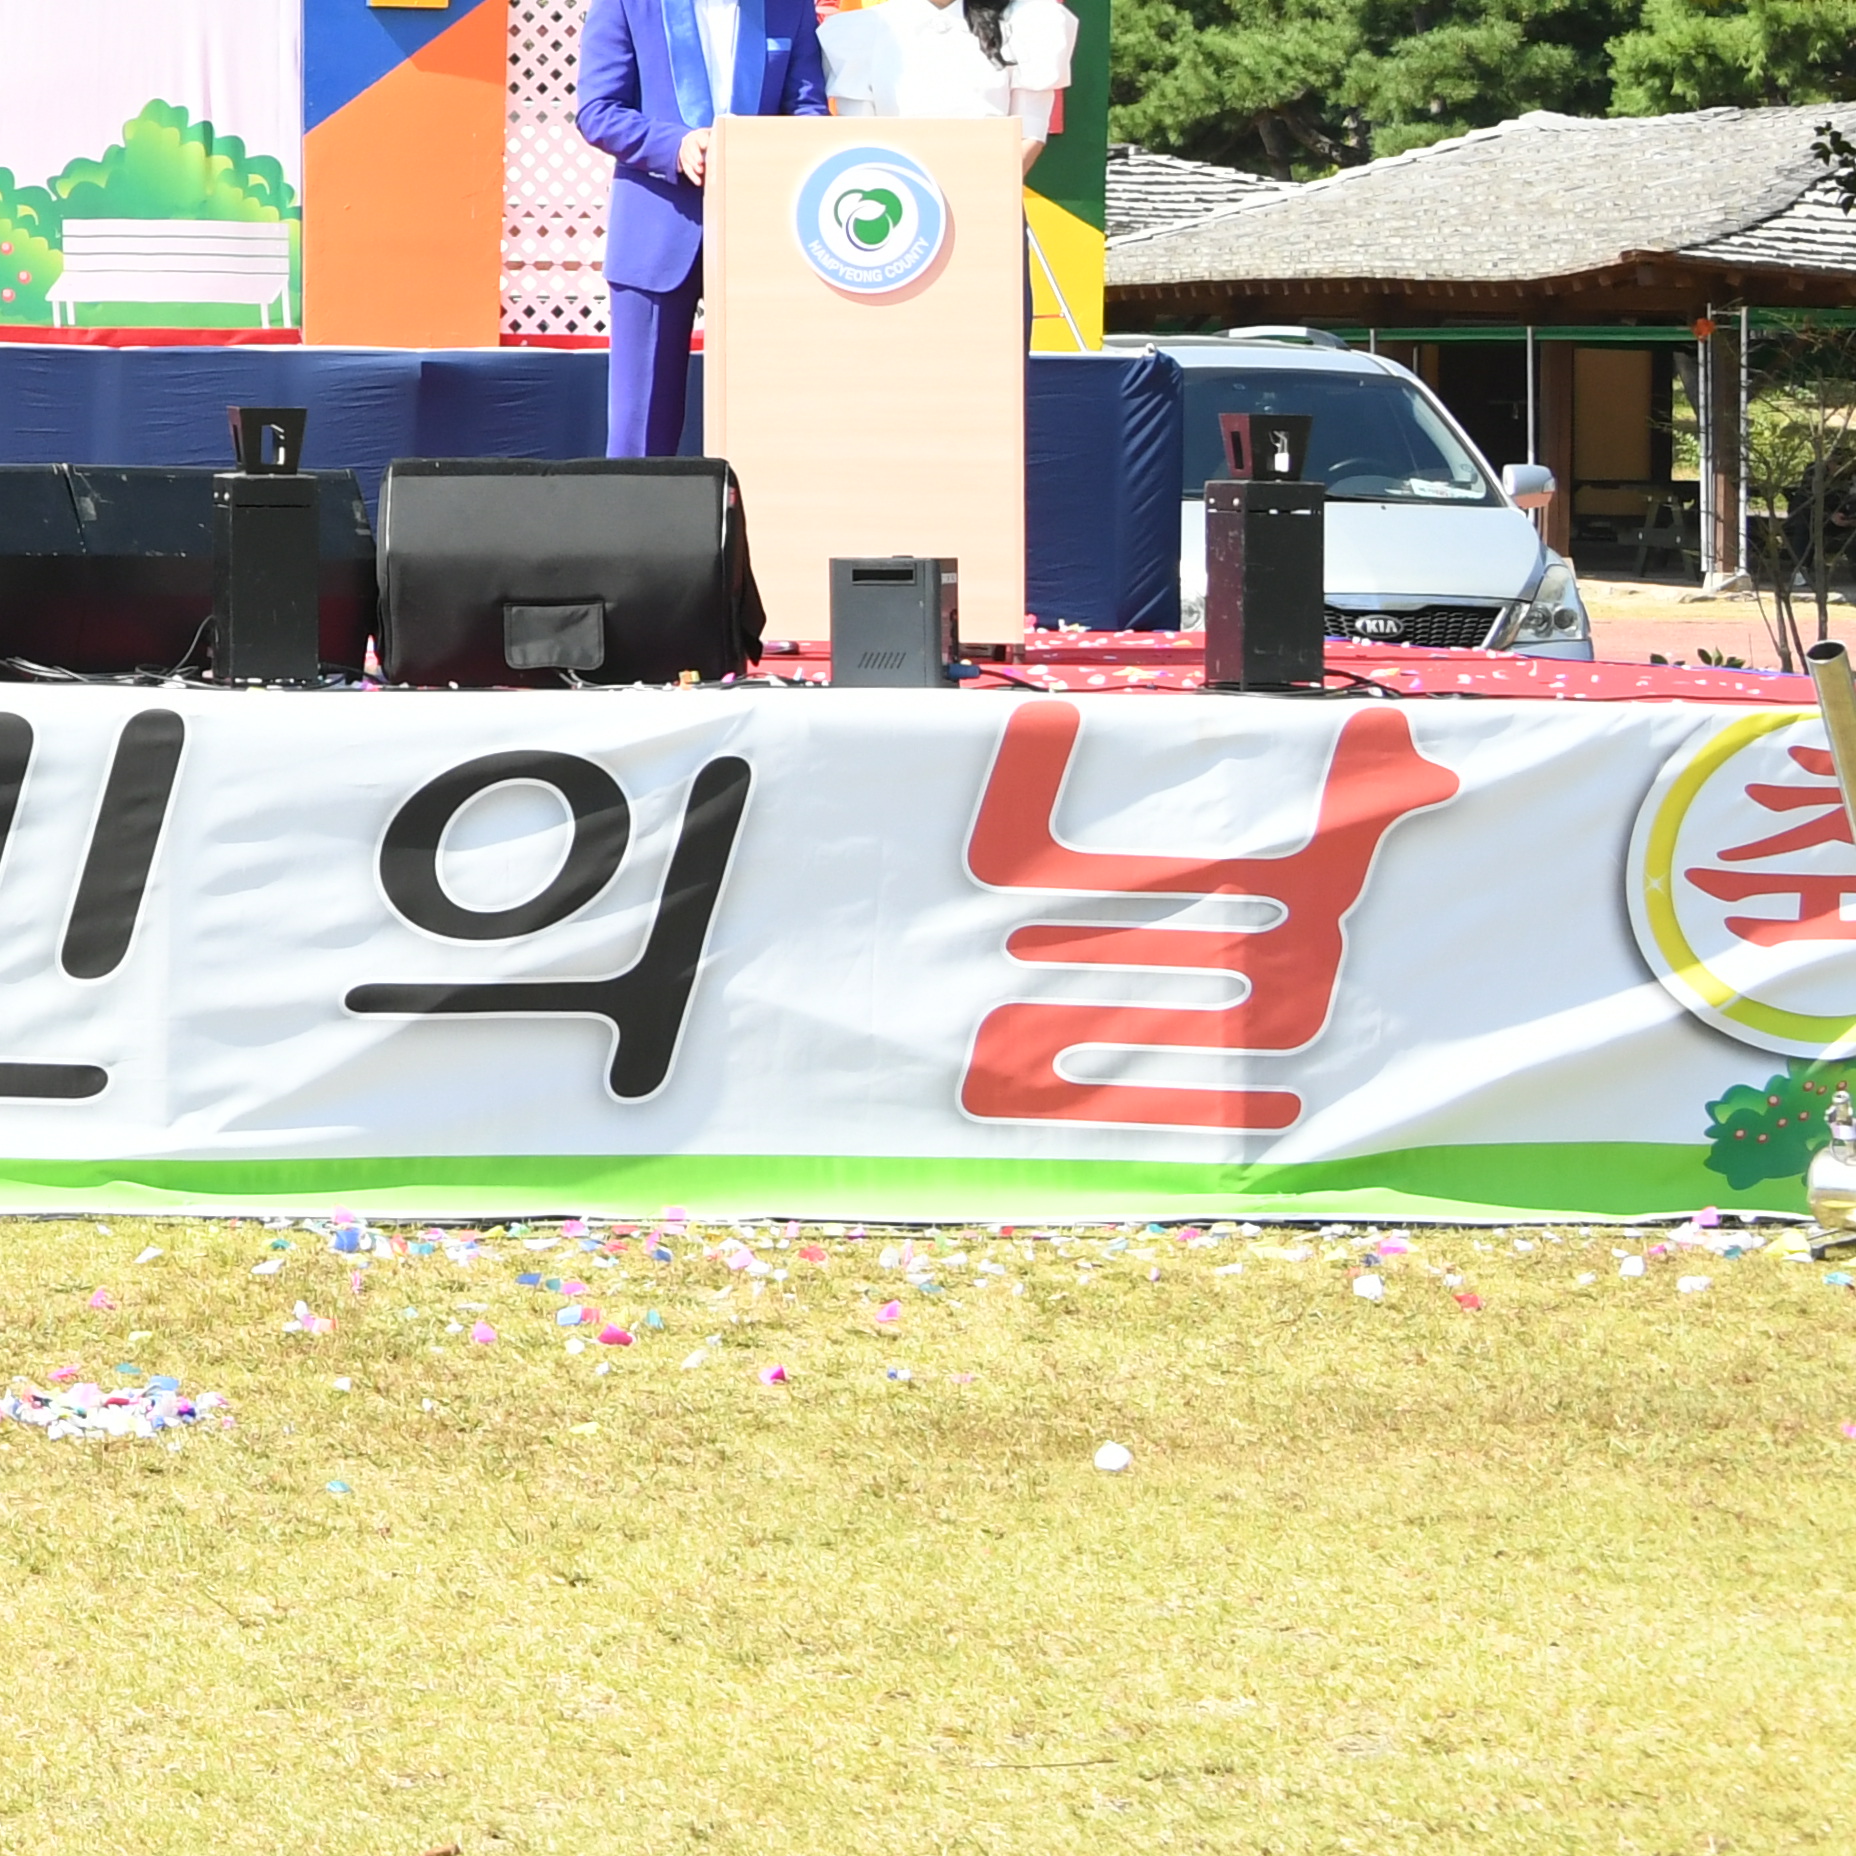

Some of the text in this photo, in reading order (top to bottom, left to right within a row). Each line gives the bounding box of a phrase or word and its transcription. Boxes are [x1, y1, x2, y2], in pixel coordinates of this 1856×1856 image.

[809, 237, 930, 282] HAMPYEONG COUNTY
[1365, 619, 1398, 634] KIA
[960, 699, 1462, 1129] 날
